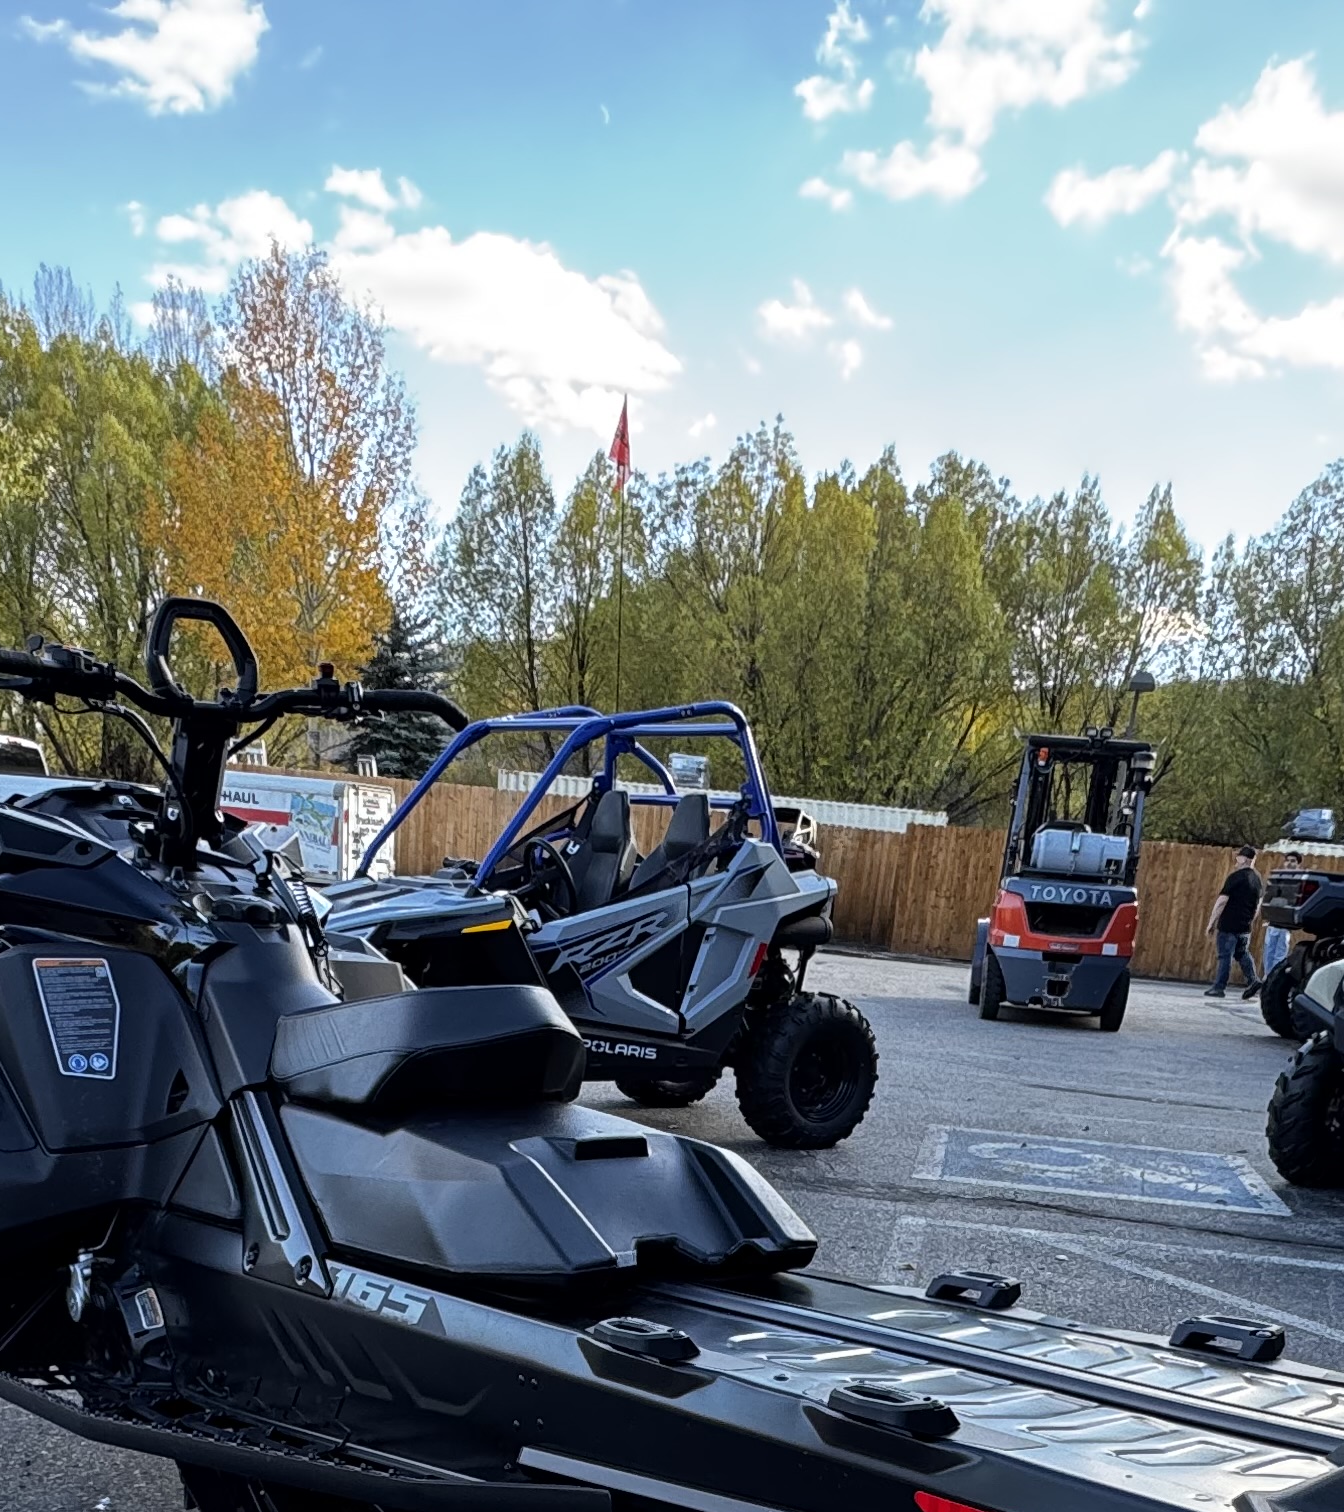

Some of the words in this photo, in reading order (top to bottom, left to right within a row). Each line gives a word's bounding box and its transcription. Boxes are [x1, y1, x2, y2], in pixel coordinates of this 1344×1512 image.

[1030, 884, 1113, 907] TOYOTA
[547, 911, 669, 975] RZR
[581, 1039, 657, 1060] POLARIS
[331, 1268, 428, 1326] 165
